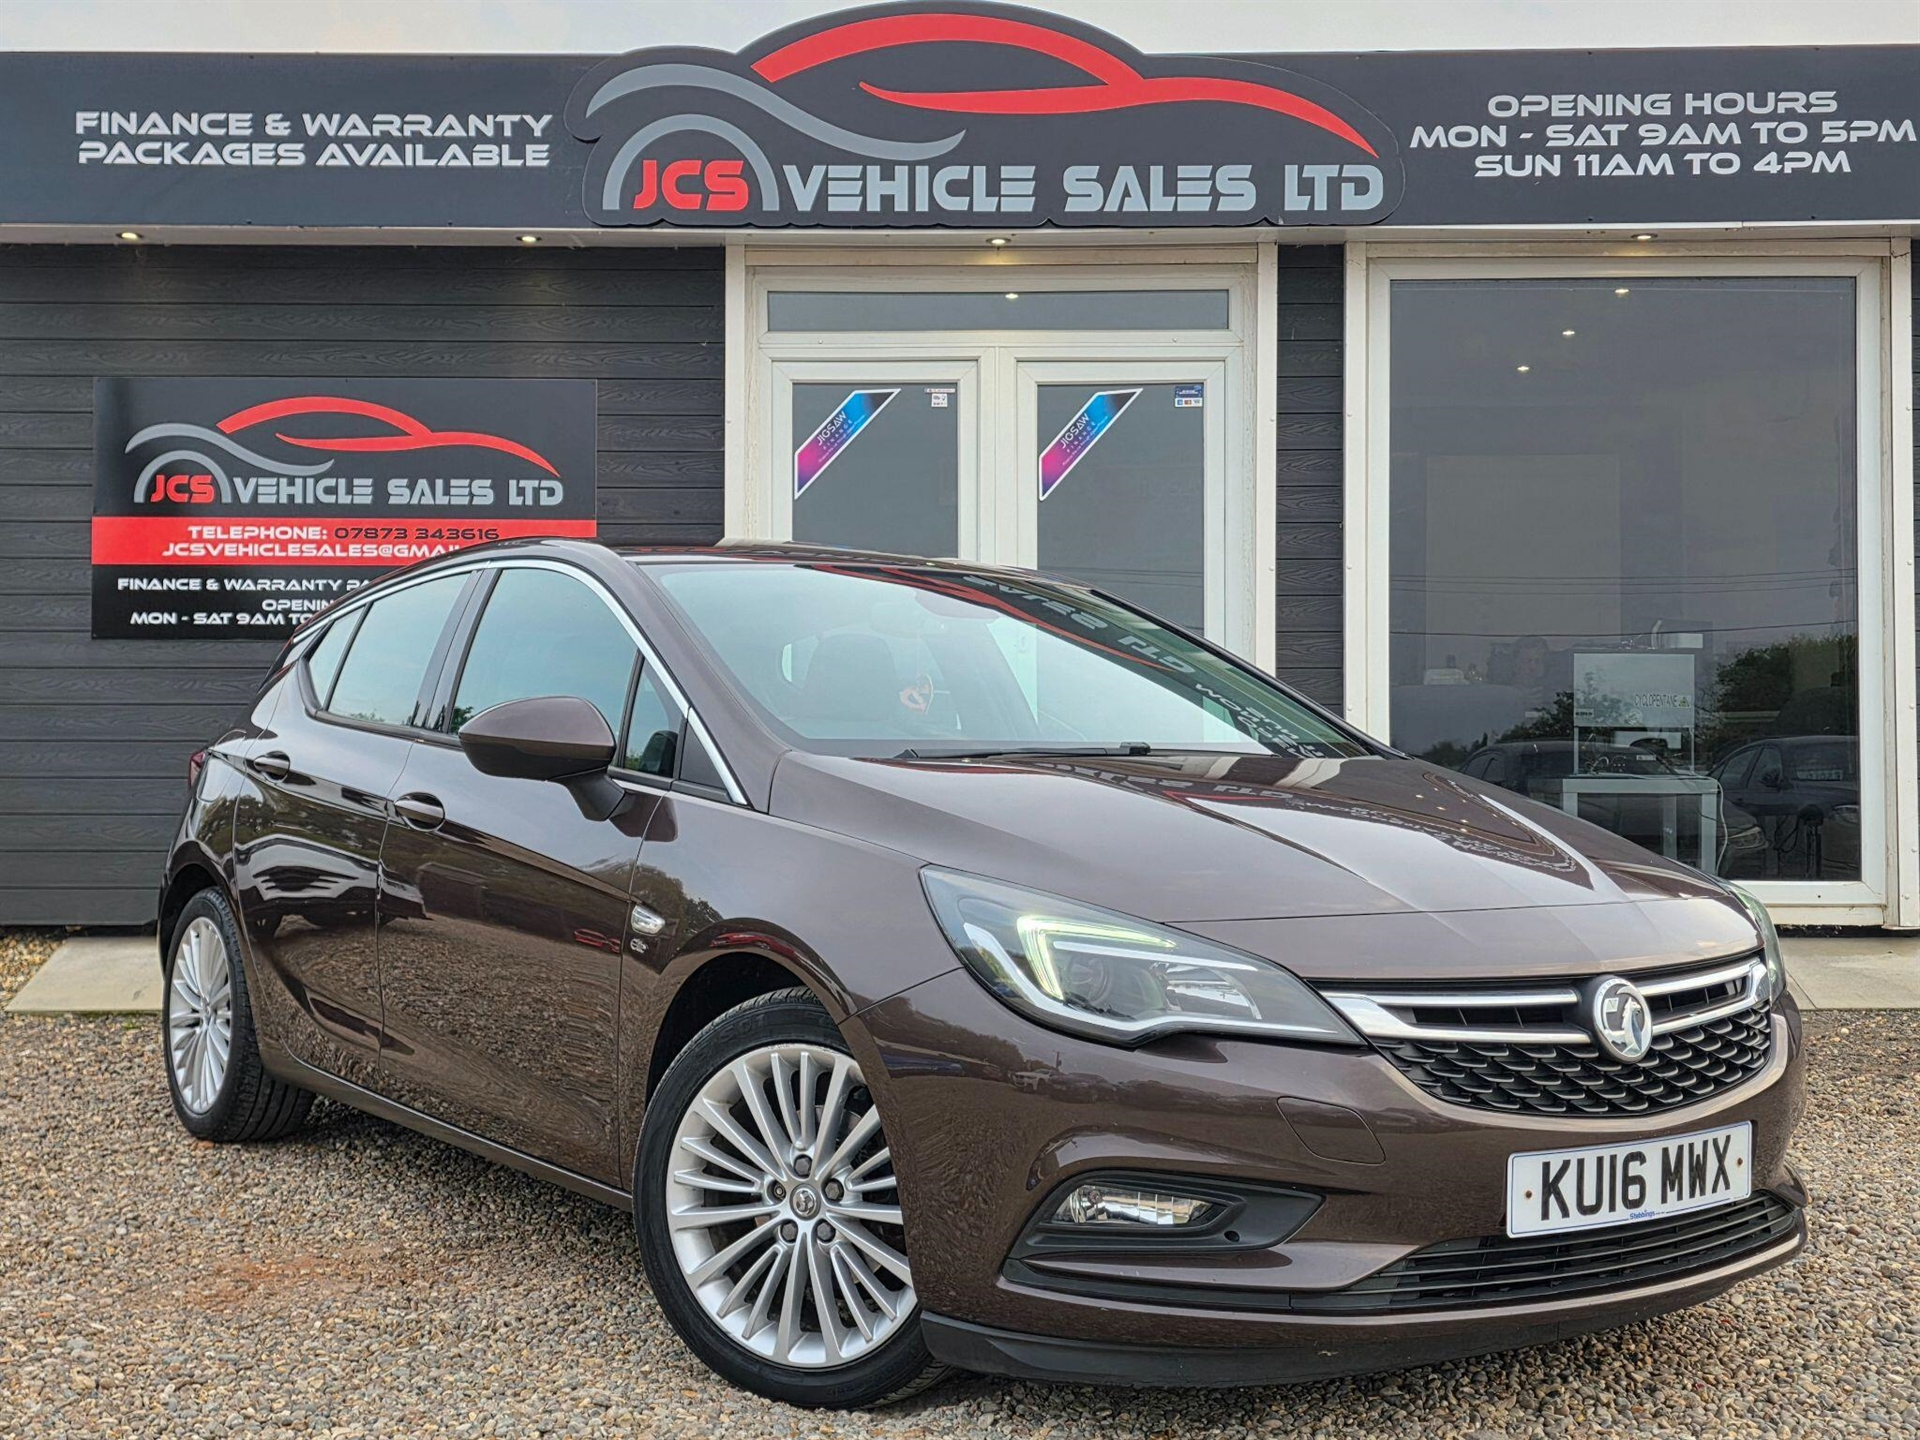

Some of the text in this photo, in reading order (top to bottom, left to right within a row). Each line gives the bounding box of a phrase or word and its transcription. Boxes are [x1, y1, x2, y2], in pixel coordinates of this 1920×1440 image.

[1487, 90, 1839, 118] OPENING HOURS
[75, 110, 553, 137] FINANCE & WARRANTY
[1409, 118, 1918, 149] MON - SAT 9AM TO 5PM
[77, 141, 551, 168] PACKAGES AVAILABLE
[1473, 149, 1853, 178] SUN 11AM TO 4PM
[632, 158, 1385, 213] JCS VEHICLE SALES LTD
[816, 410, 847, 446] JIGSAW
[1060, 412, 1090, 449] JIGSAW
[149, 474, 564, 507] JCS VEHICLE SALES LTD
[187, 525, 500, 541] TELEPHONE: 07873 343616
[117, 577, 202, 592] FINANCE
[205, 578, 220, 592] &
[223, 578, 344, 592] WARRANTY
[129, 611, 178, 625] MON
[193, 612, 233, 625] SAT
[235, 612, 286, 625] 9AM
[1540, 1134, 1732, 1221] KU16 MWX
